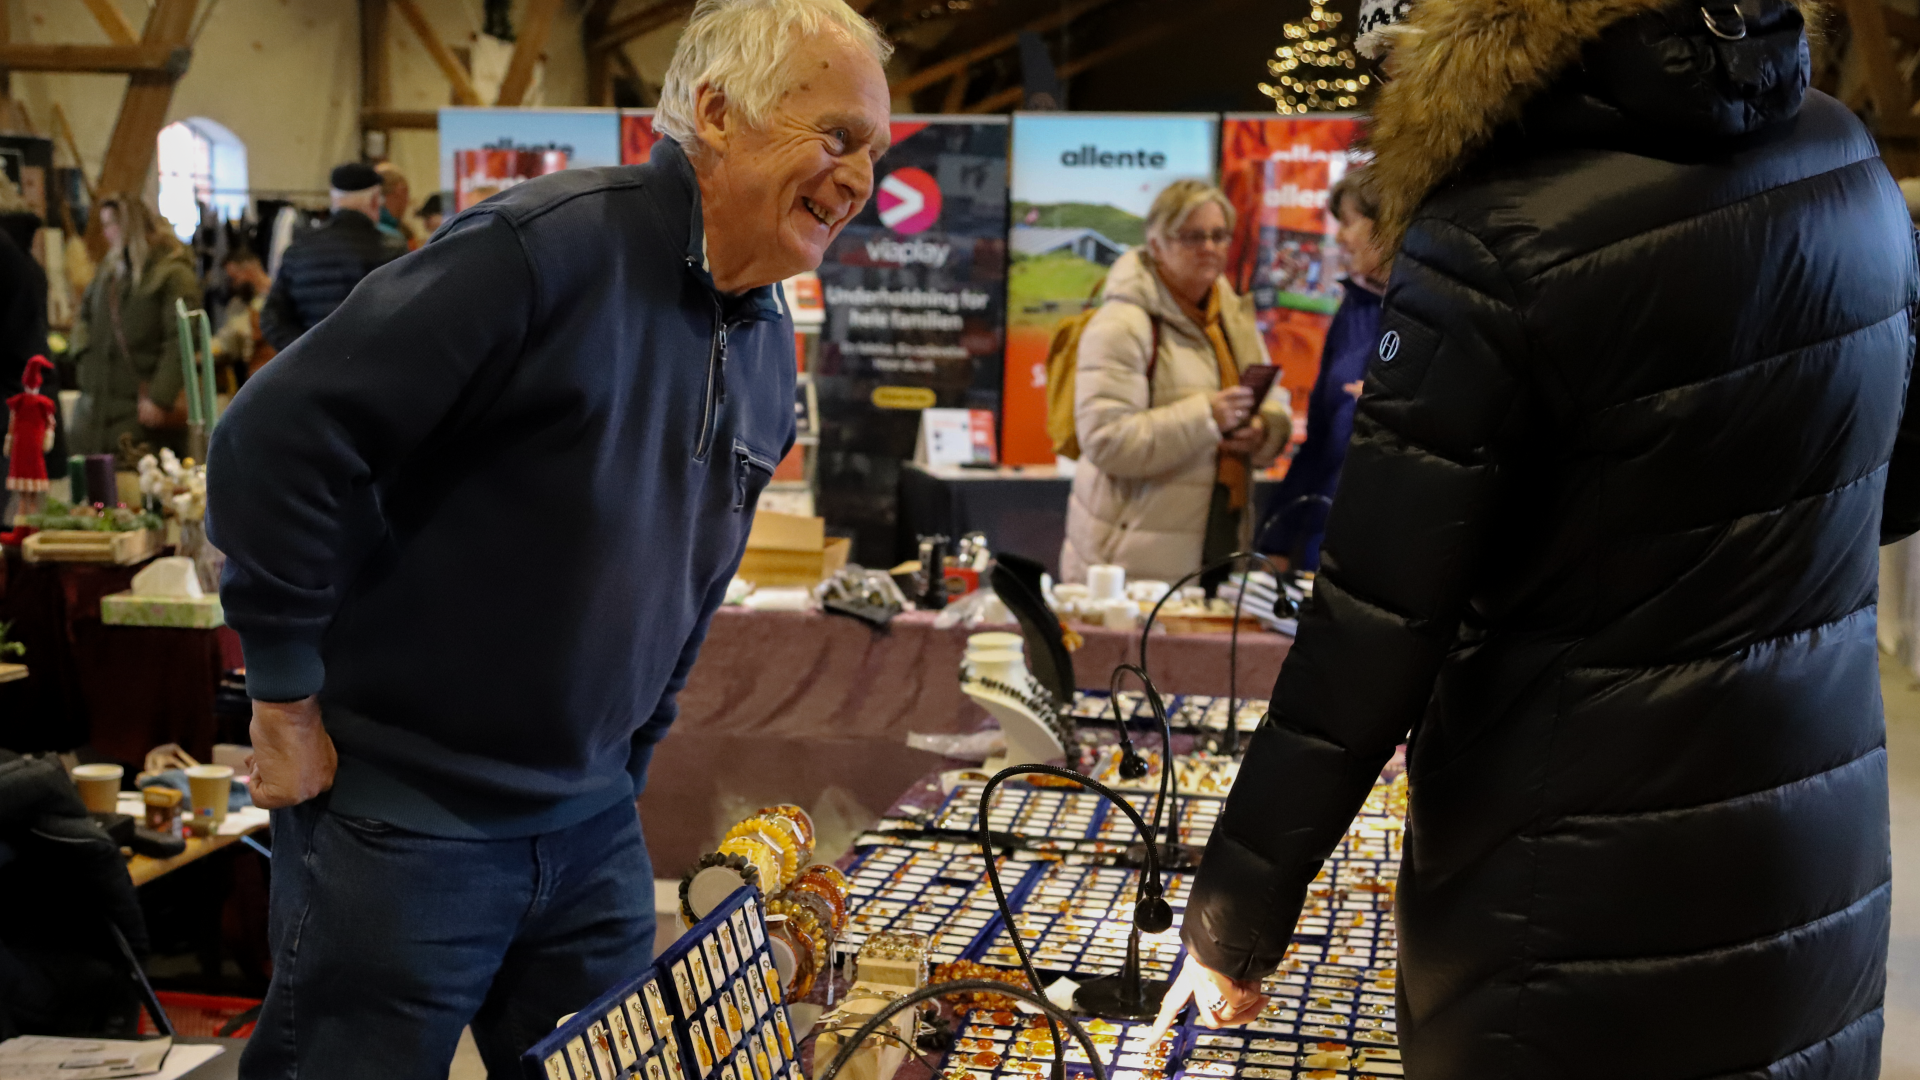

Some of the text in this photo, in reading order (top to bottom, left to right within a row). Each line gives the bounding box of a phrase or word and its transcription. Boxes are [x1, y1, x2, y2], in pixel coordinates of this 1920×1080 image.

[1060, 144, 1166, 168] allente
[865, 238, 951, 266] viaplay
[825, 286, 960, 313] Underholdning
[960, 289, 990, 310] for
[848, 309, 965, 331] hele familien
